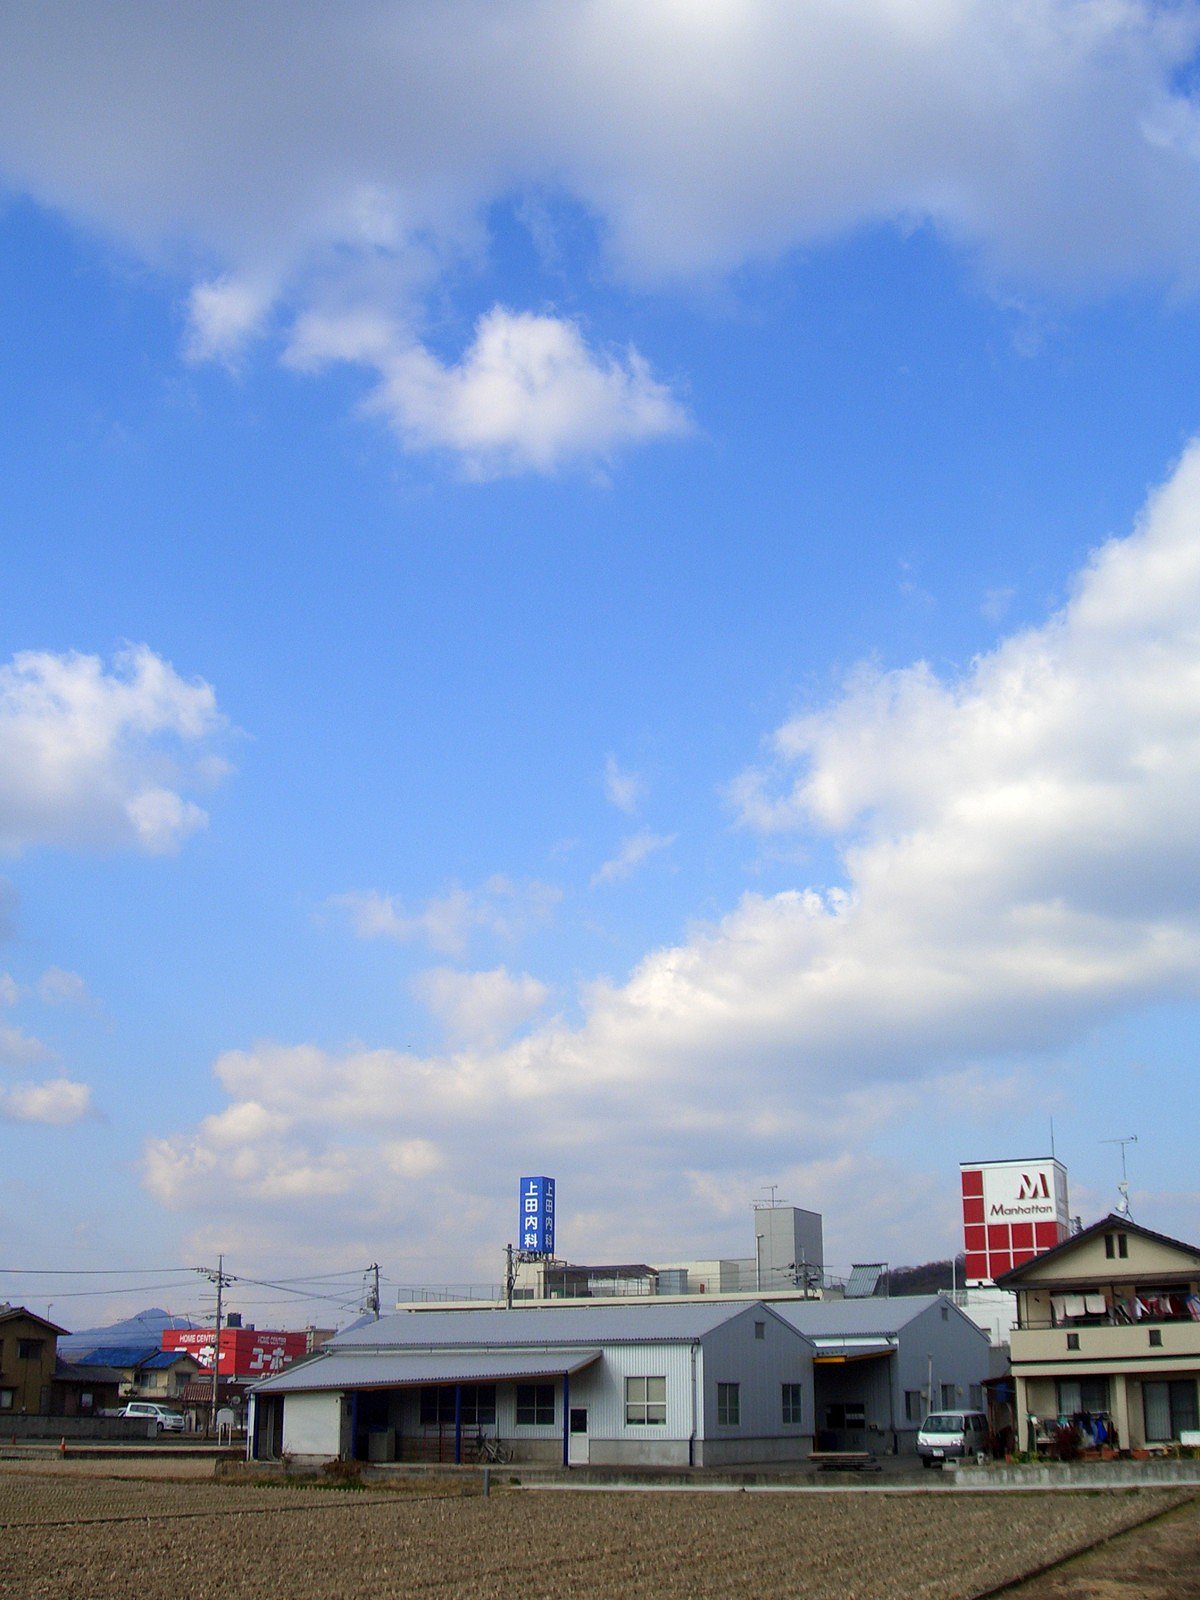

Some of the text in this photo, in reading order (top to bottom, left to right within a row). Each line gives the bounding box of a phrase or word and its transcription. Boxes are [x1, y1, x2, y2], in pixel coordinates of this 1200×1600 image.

[1016, 1172, 1051, 1200] M
[524, 1181, 538, 1248] 上田内科
[545, 1182, 553, 1248] 上田内科
[990, 1203, 1053, 1216] Manhattan
[179, 1334, 217, 1343] HOME CENTE
